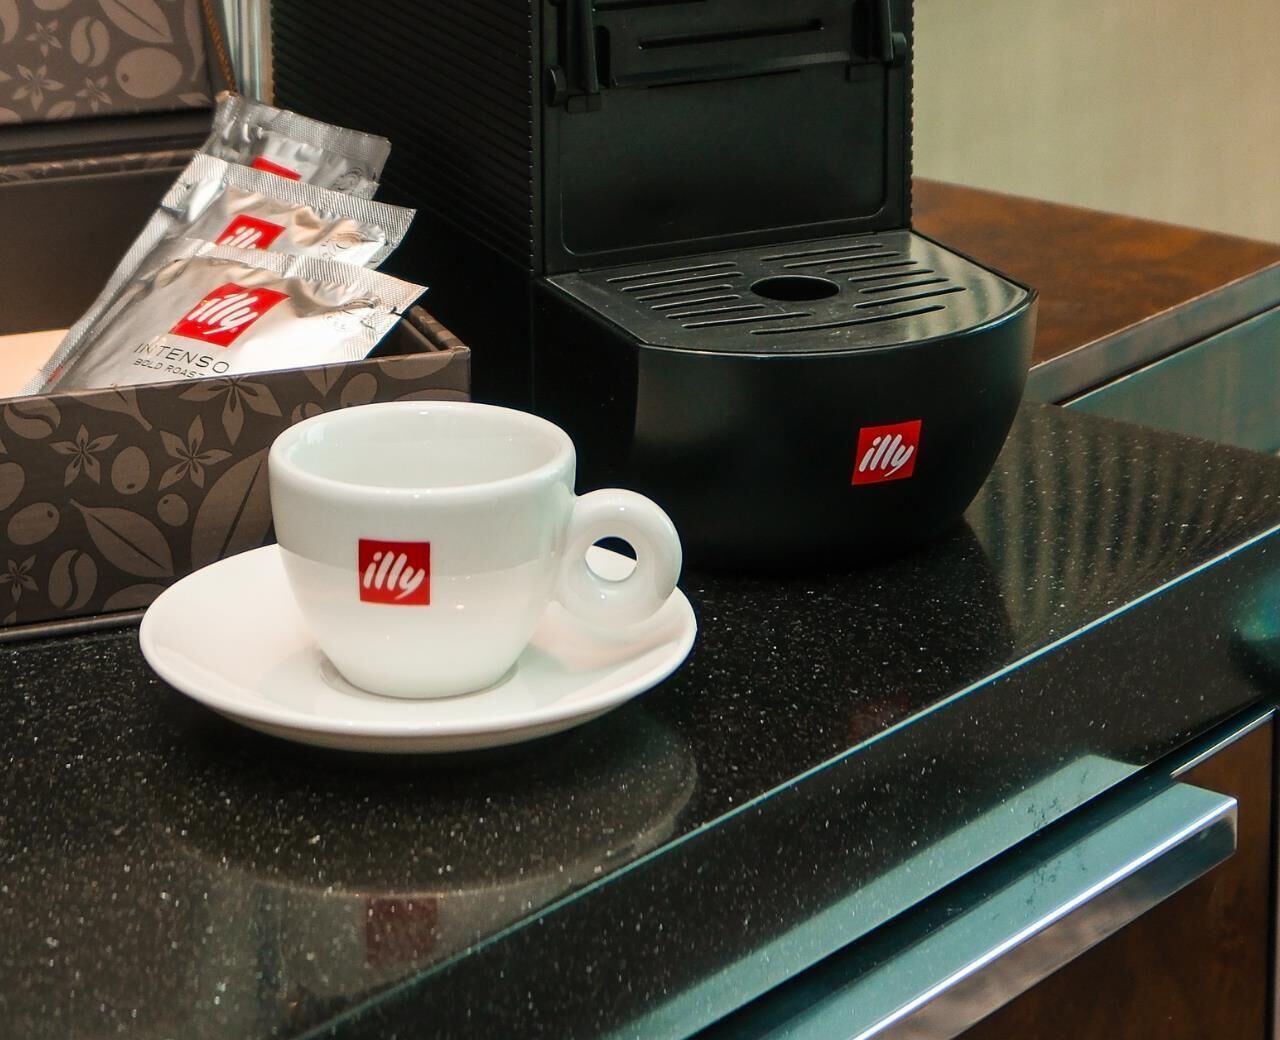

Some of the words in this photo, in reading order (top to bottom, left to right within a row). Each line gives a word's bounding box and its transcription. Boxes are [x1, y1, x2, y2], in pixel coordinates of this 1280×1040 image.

[221, 226, 262, 250] ill
[187, 292, 260, 335] illy
[133, 342, 230, 374] INTENSO
[133, 357, 163, 370] BOLD
[858, 433, 915, 477] illy
[363, 551, 425, 600] illy
